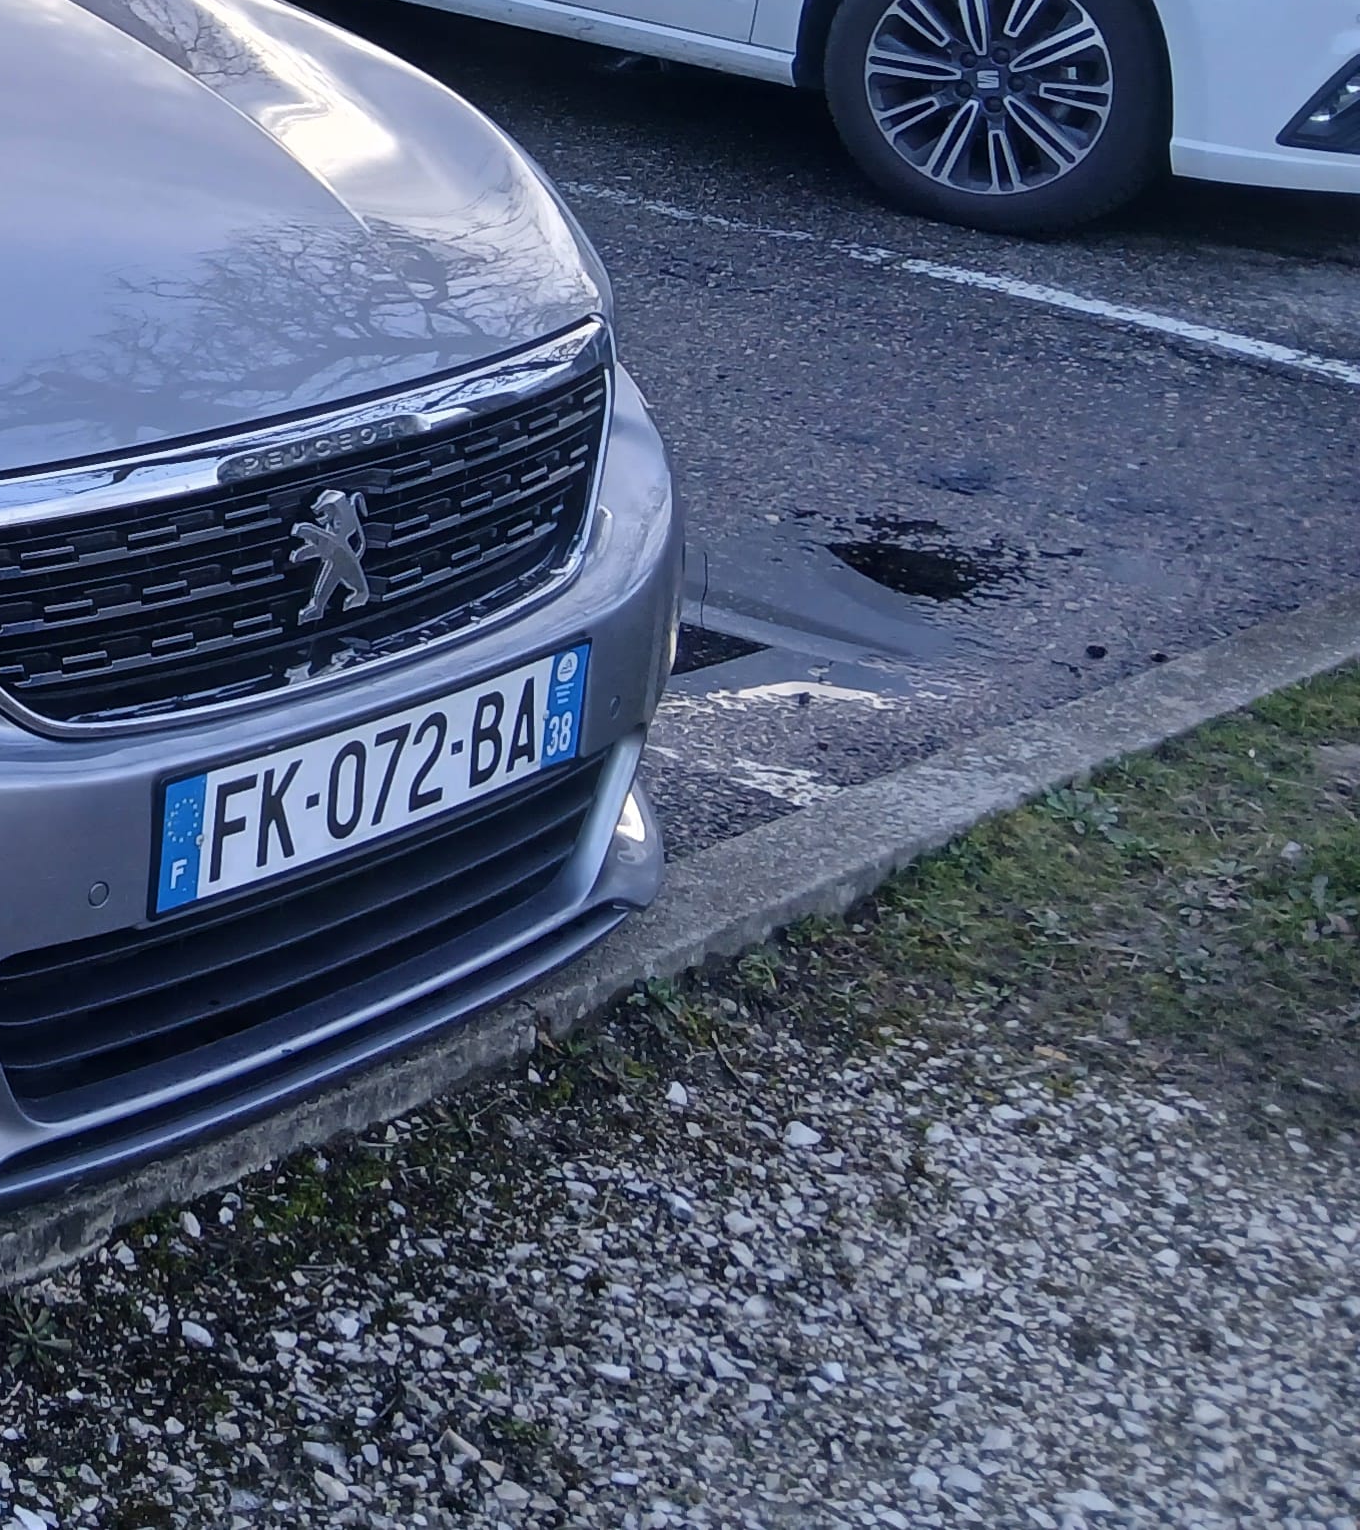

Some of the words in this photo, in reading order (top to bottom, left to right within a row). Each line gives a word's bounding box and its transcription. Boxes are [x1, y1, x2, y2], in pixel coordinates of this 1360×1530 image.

[243, 421, 396, 476] PEUGEOT
[546, 711, 573, 757] 38
[208, 677, 536, 884] FK-072-BA
[170, 859, 187, 890] F
